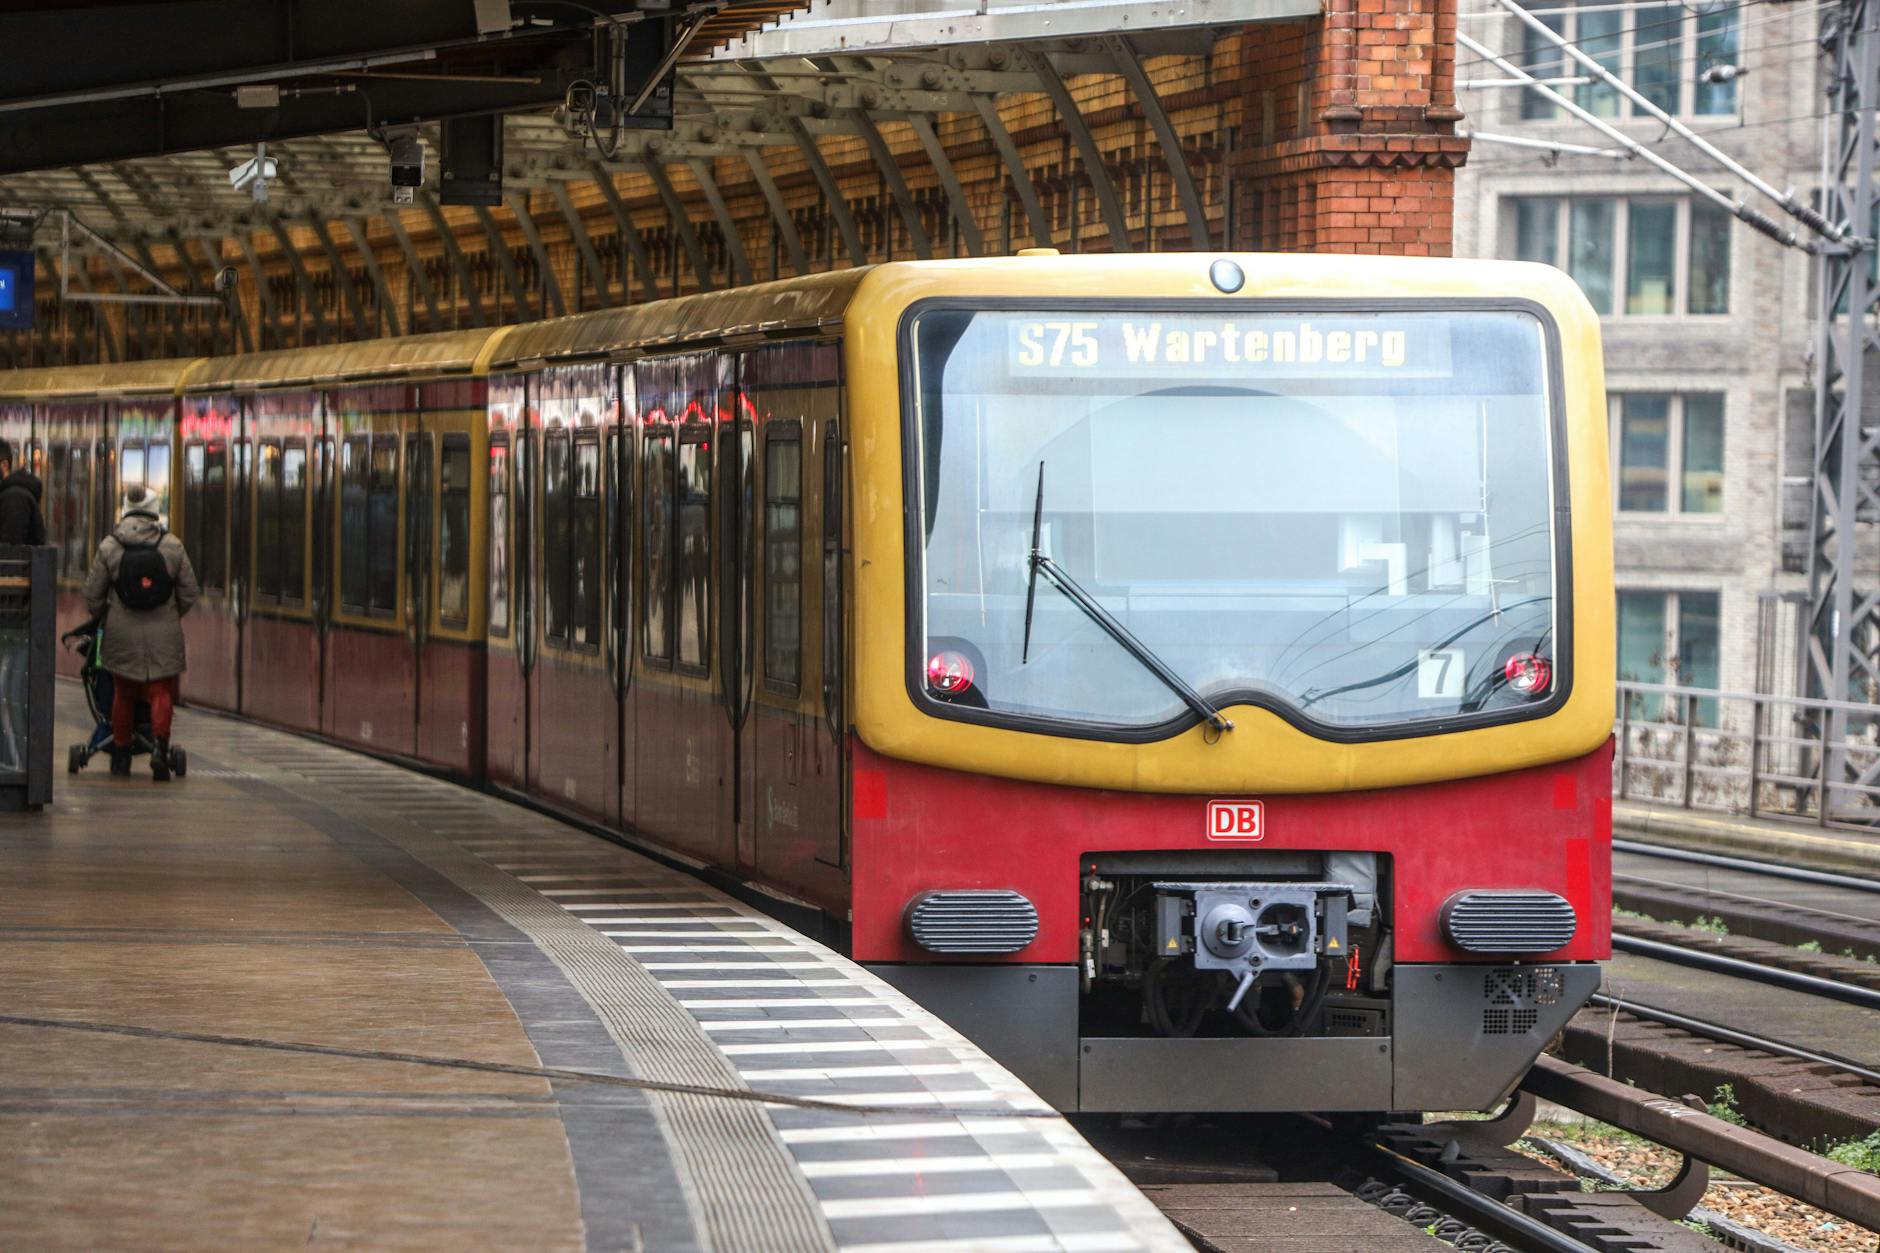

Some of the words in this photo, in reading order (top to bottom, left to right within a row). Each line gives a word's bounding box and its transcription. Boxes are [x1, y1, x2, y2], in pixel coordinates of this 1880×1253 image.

[1018, 321, 1099, 368] S75
[1122, 322, 1406, 367] Wartenberg
[1429, 653, 1453, 695] 7
[1214, 806, 1257, 834] DB
